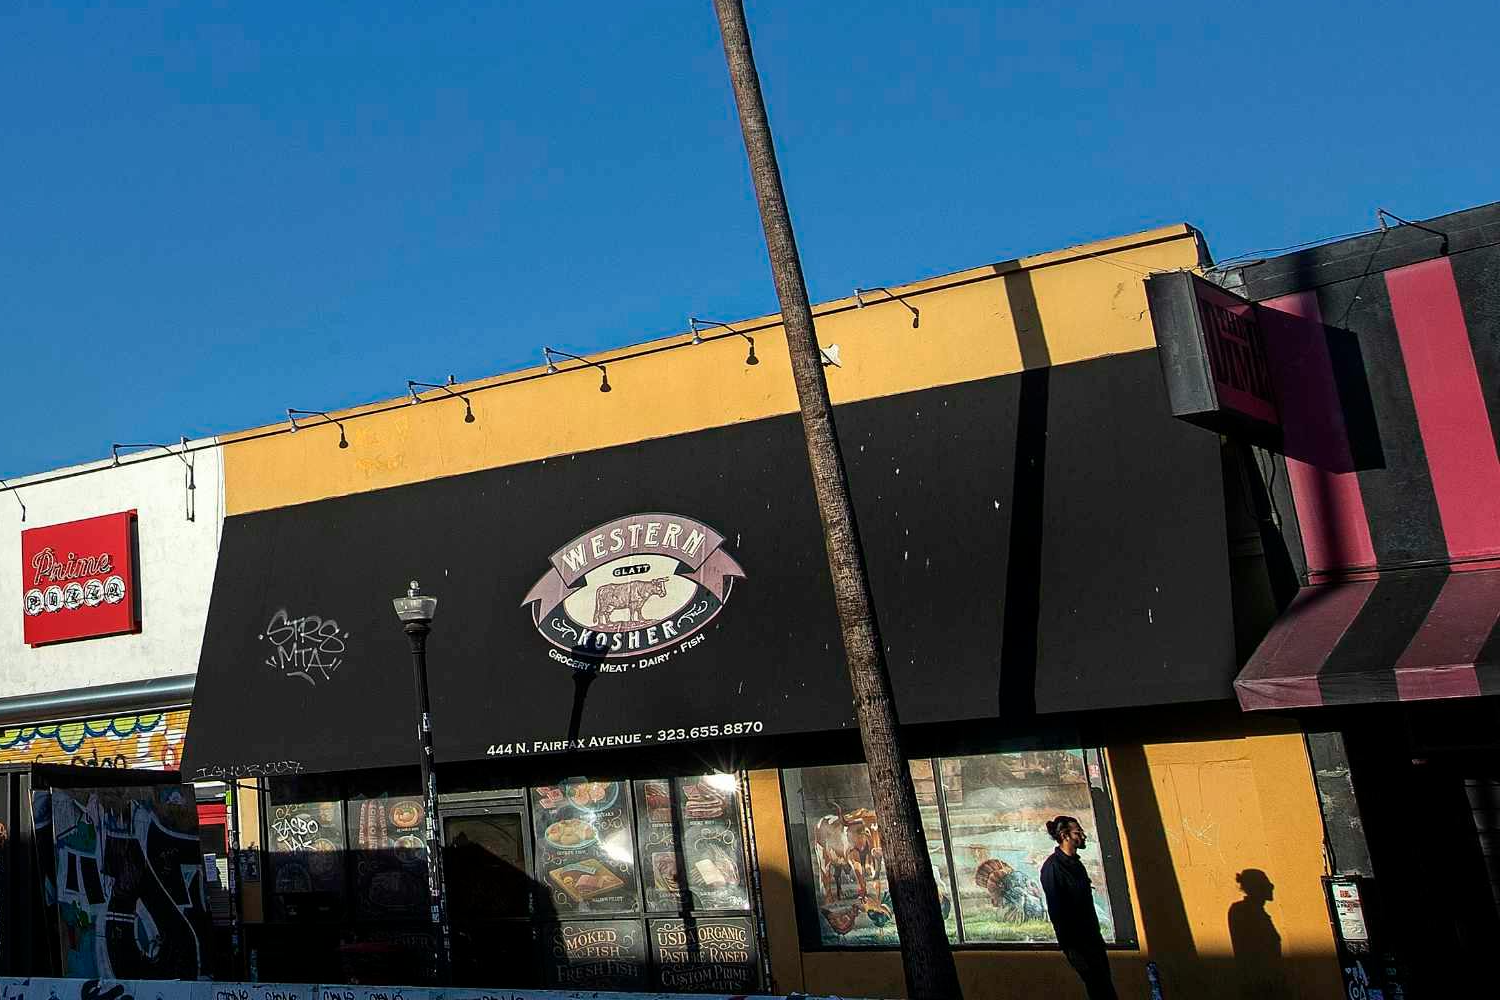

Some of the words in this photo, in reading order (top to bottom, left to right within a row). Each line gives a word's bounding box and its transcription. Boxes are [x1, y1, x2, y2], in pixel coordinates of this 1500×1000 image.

[561, 521, 706, 572] WESTERN
[31, 547, 112, 585] Prime
[614, 564, 650, 577] GLATT
[25, 578, 122, 614] PIZZA
[576, 619, 678, 652] KOSHER
[486, 743, 513, 757] 444
[515, 742, 530, 755] N.
[657, 720, 764, 742] 323.655.8870
[553, 929, 618, 957] SMOKED
[657, 931, 696, 947] USDA
[697, 926, 747, 942] ORGANIC
[587, 946, 620, 958] FISH
[709, 948, 749, 964] RAISED
[556, 964, 604, 984] FRESH
[607, 960, 640, 977] FISH
